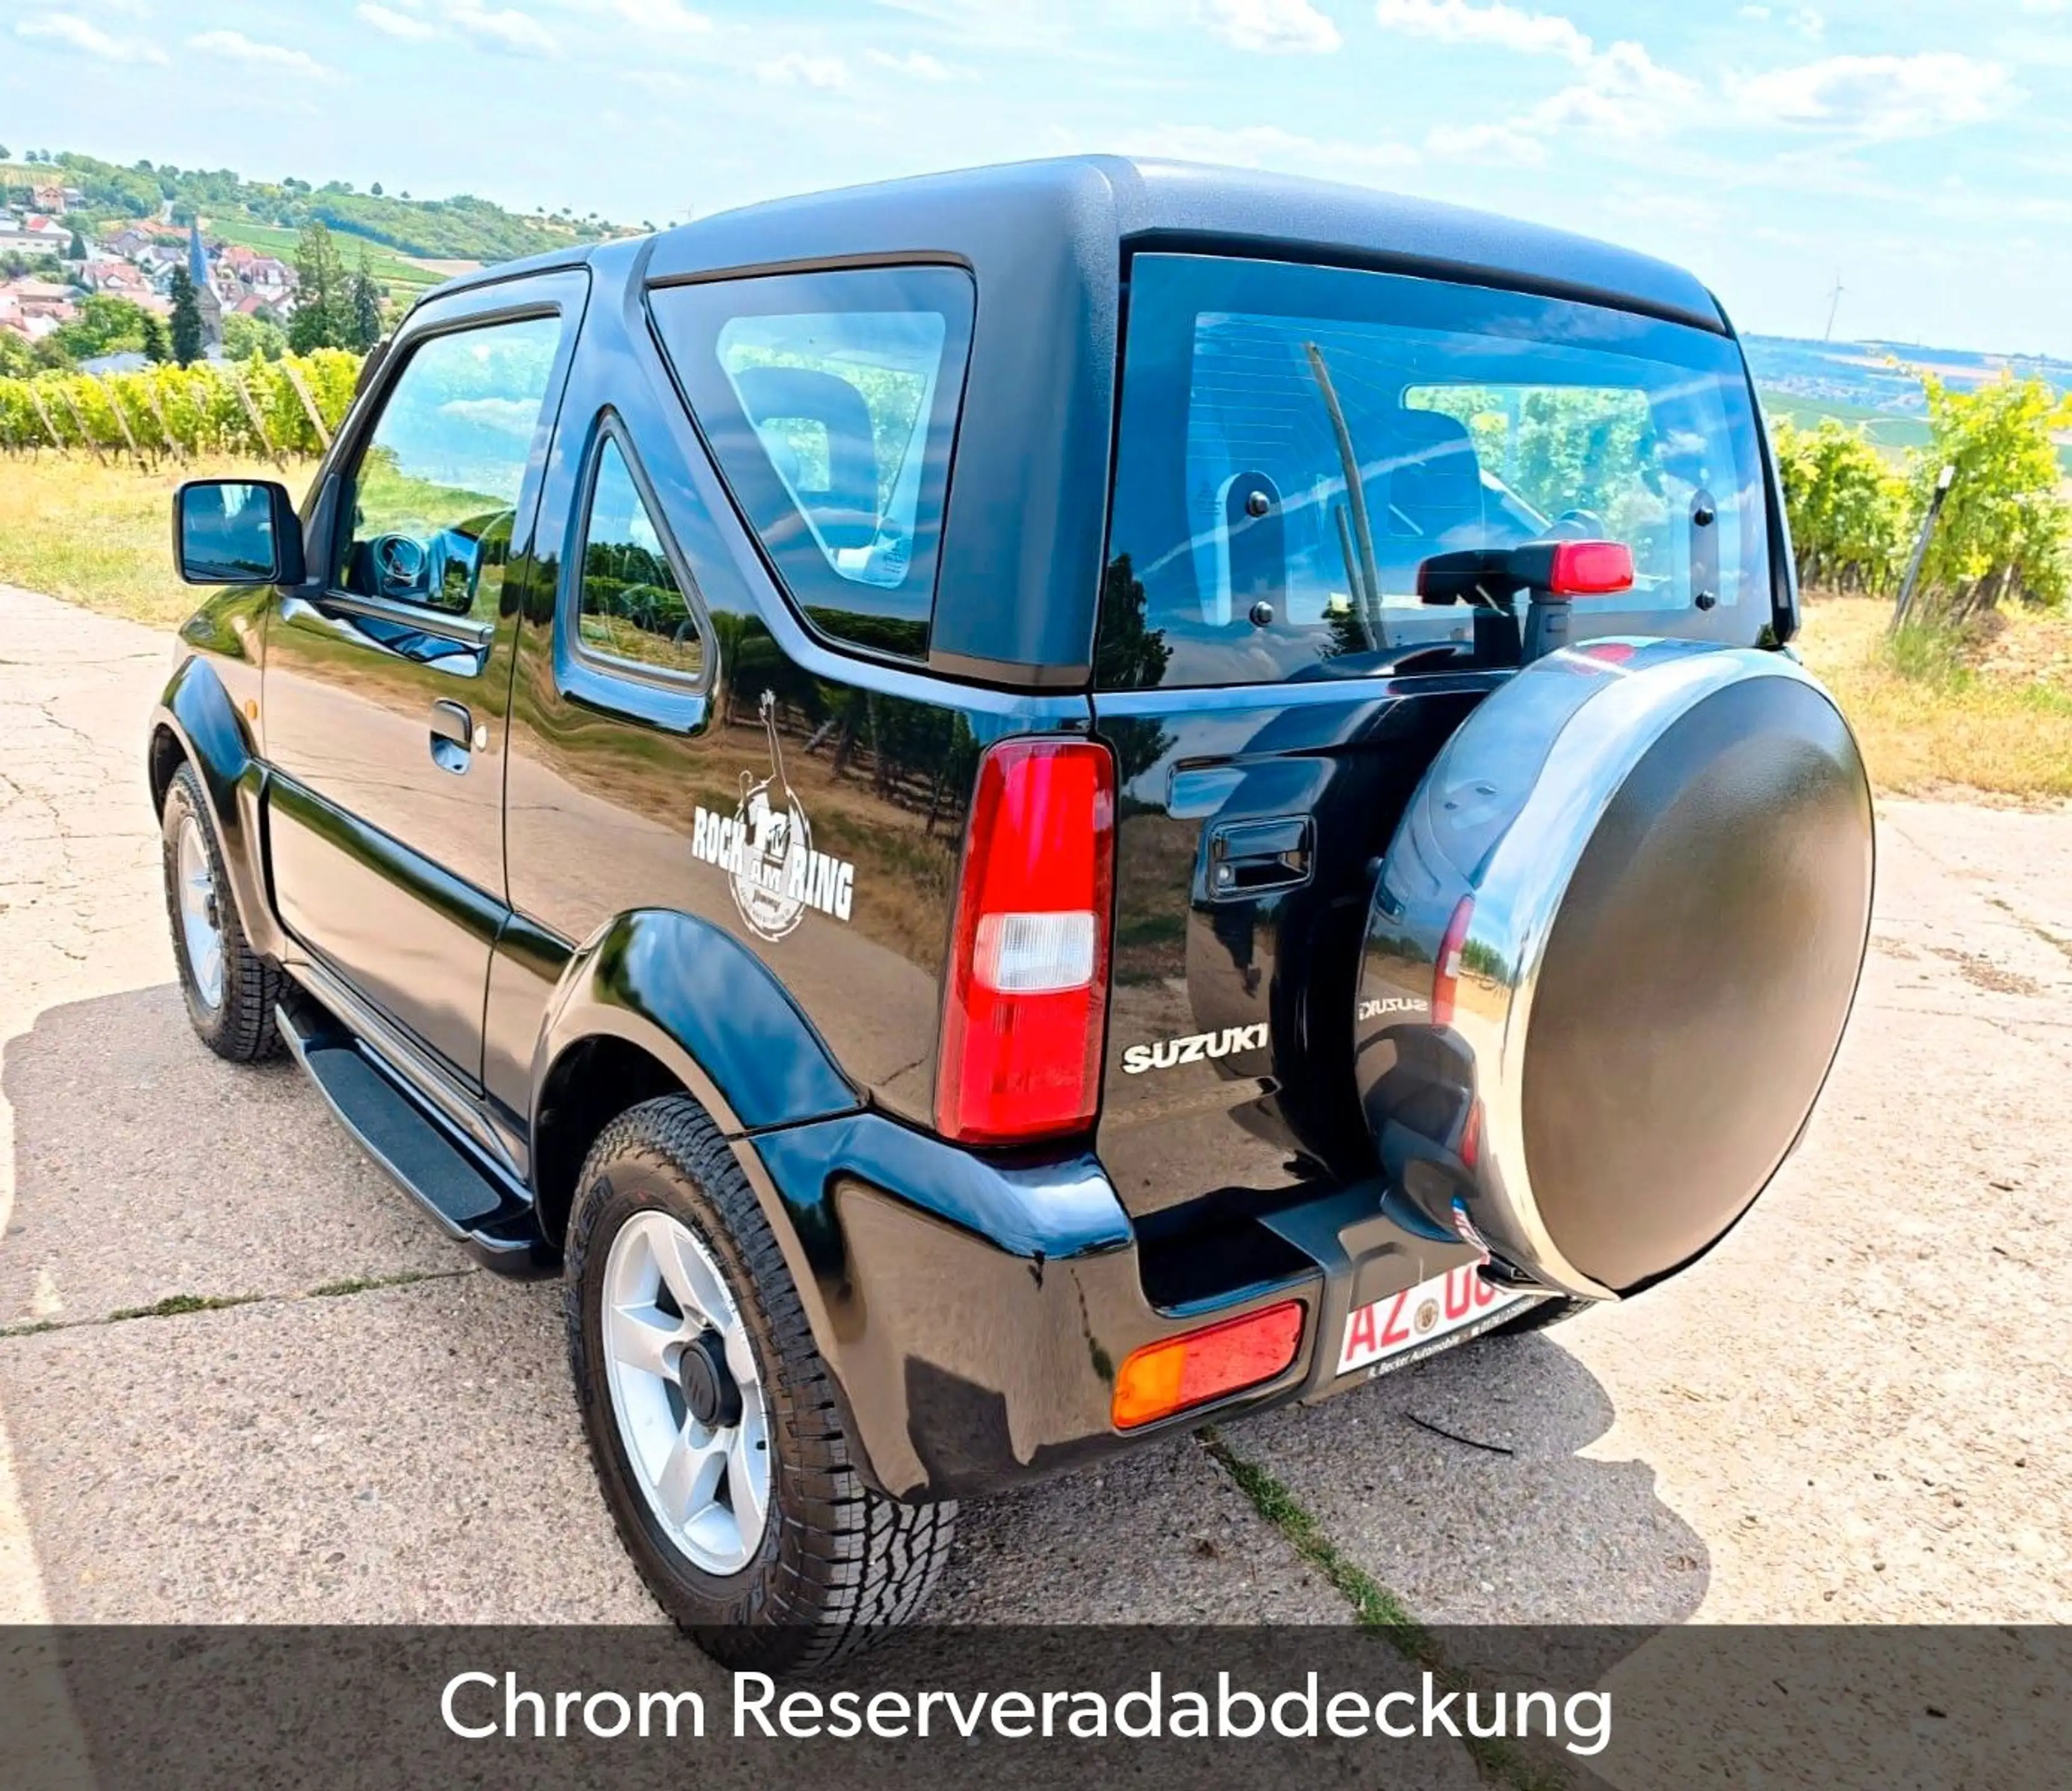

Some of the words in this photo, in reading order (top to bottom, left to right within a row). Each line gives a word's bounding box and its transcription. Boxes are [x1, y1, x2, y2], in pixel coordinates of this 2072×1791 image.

[692, 806, 747, 876] ROCK
[750, 859, 781, 892] AM
[788, 842, 854, 922] RING
[1122, 1023, 1269, 1075] SUZUKI
[1345, 1289, 1410, 1362] AZ
